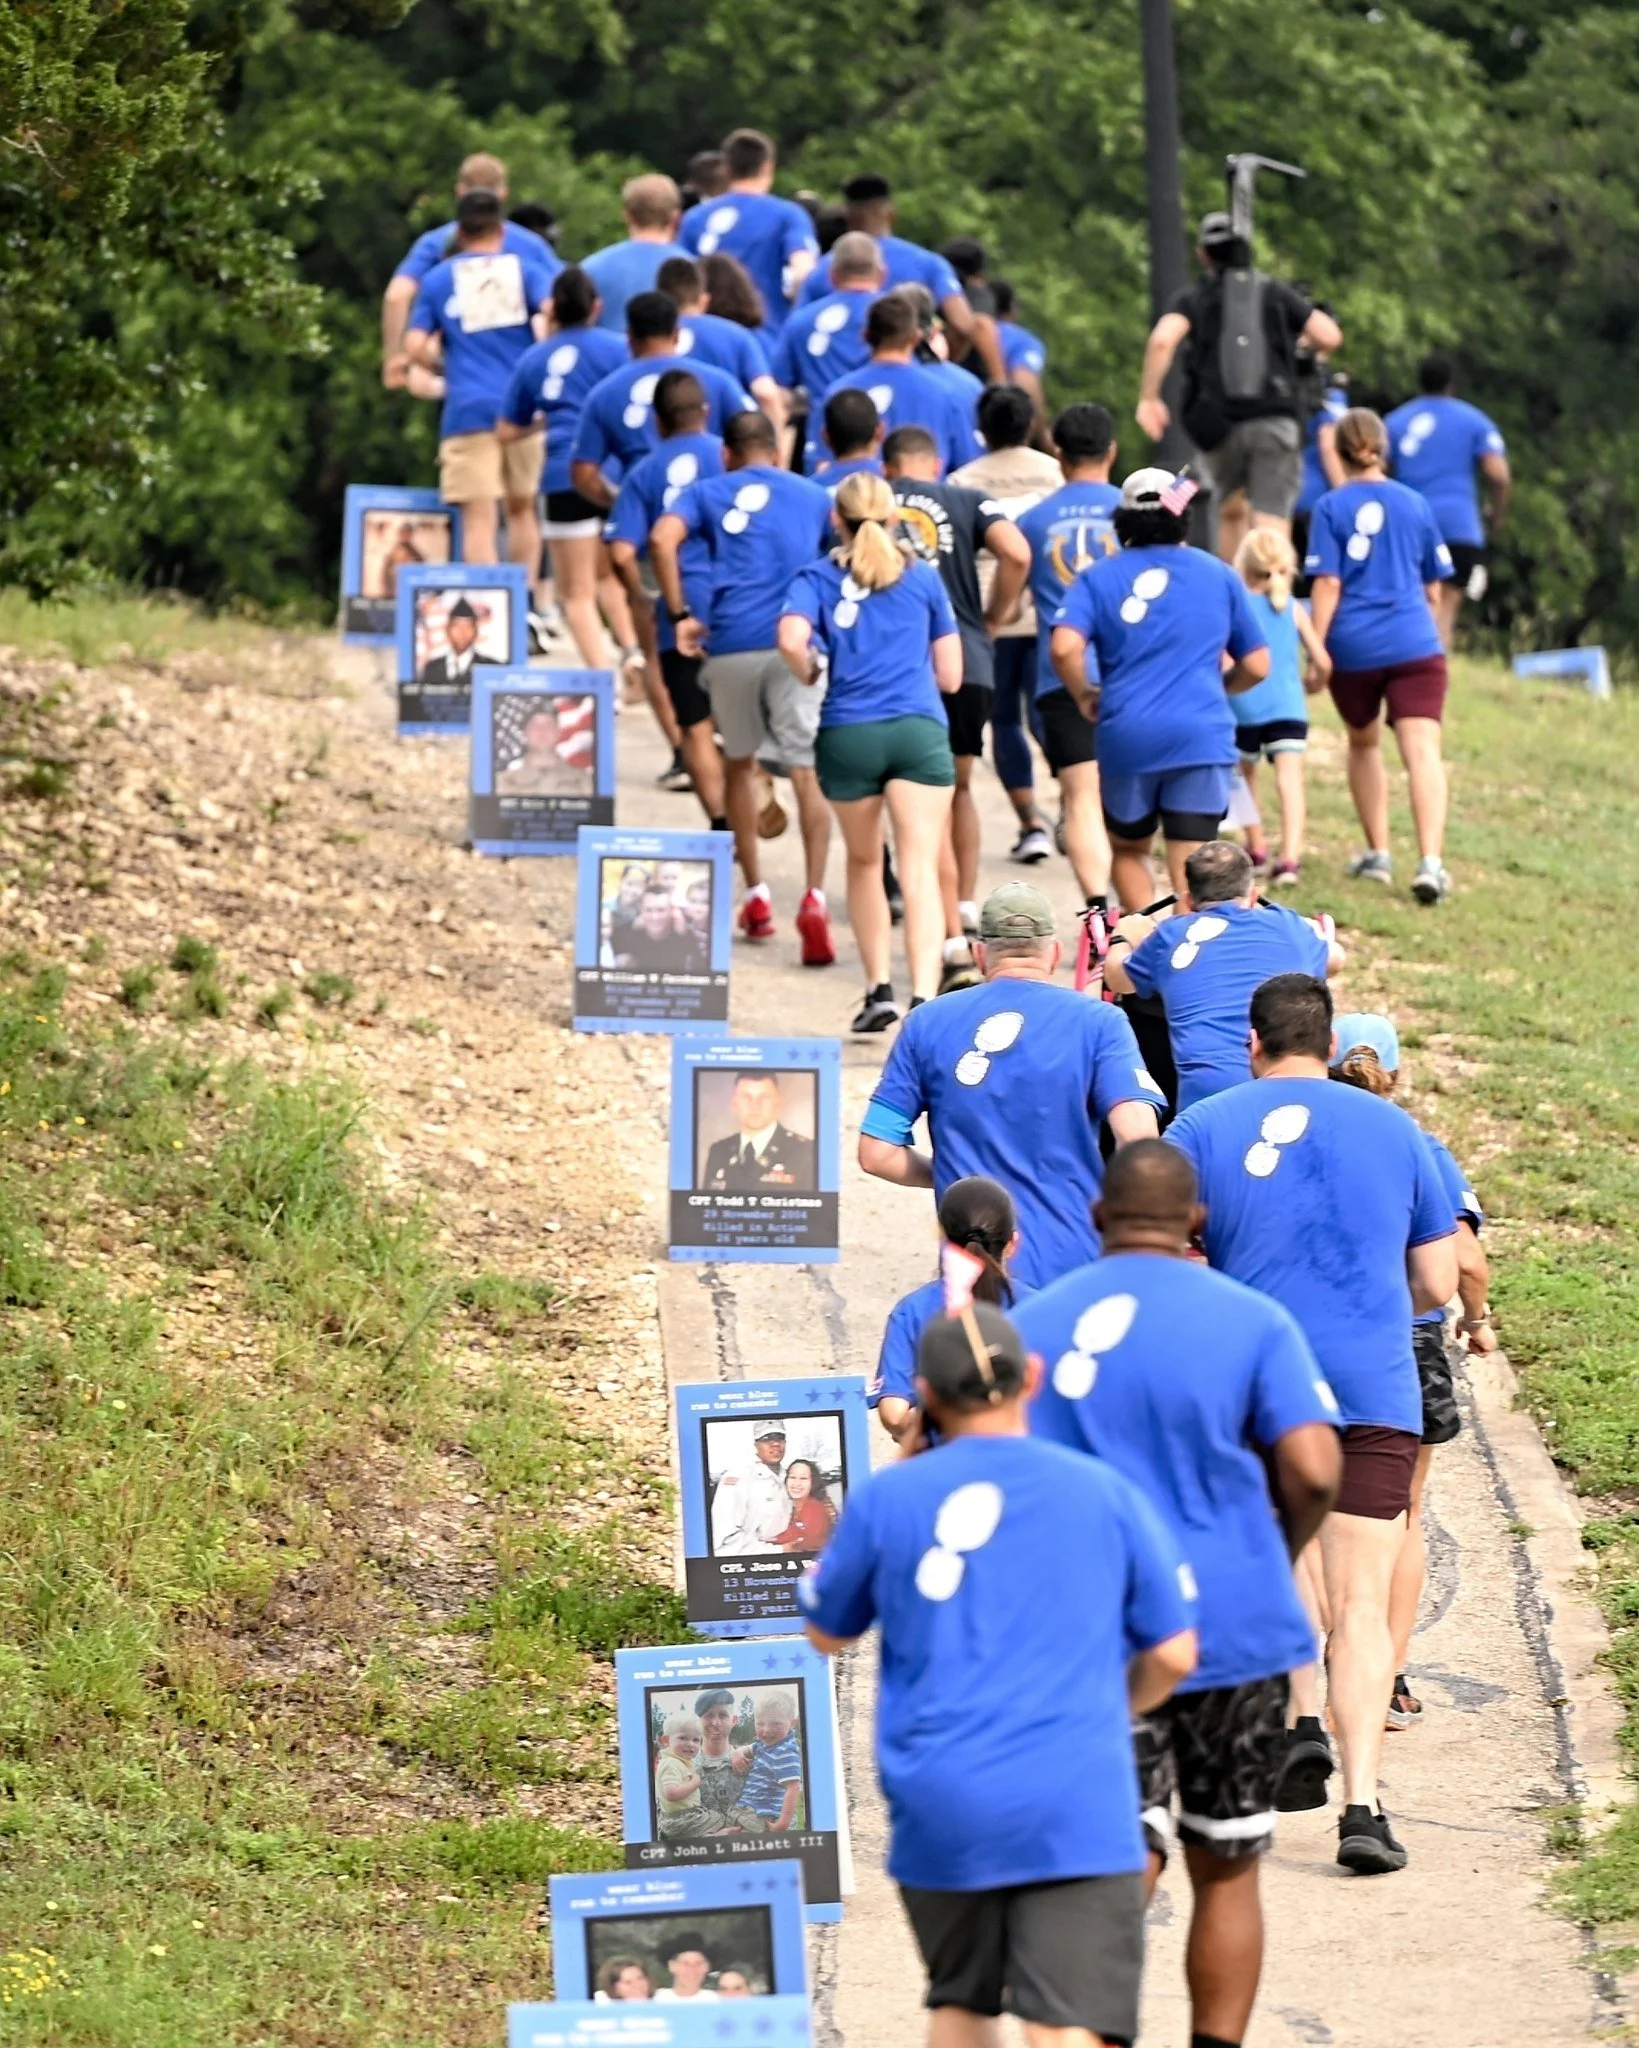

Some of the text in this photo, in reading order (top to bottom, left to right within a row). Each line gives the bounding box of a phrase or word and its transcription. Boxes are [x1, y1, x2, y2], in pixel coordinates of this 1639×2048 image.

[688, 1195, 711, 1206] CPT
[715, 1196, 744, 1206] Todd
[760, 1196, 823, 1208] Christmas
[722, 1210, 775, 1220] November
[703, 1222, 808, 1233] Killed in Action
[736, 1235, 769, 1245] years
[774, 1234, 796, 1244] old
[720, 1563, 746, 1574] CPL
[750, 1561, 782, 1572] Jose
[787, 1560, 798, 1570] A
[723, 1579, 739, 1588] 13
[723, 1590, 791, 1602] Killed in
[739, 1604, 798, 1615] 23 years
[664, 1656, 730, 1668] wear blue:
[633, 1666, 732, 1680] run to remember
[640, 1836, 824, 1859] CPT John L Hallett III
